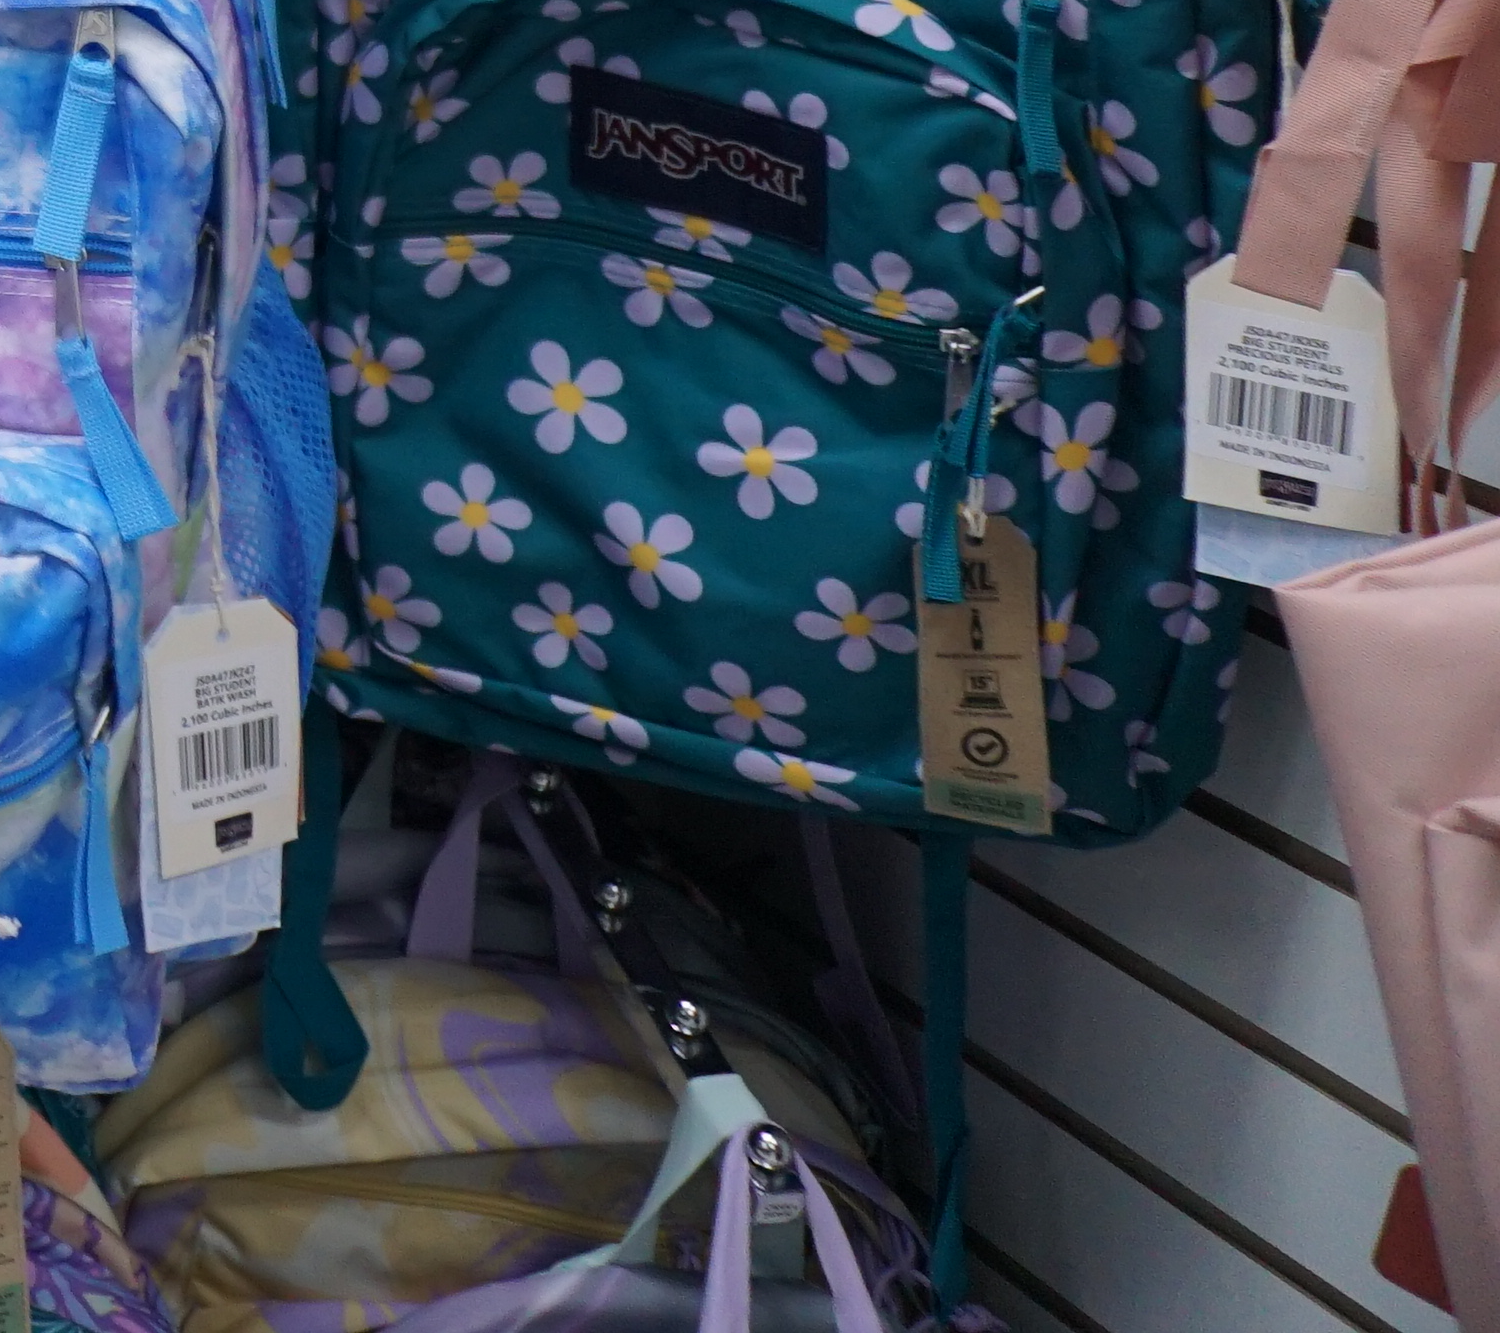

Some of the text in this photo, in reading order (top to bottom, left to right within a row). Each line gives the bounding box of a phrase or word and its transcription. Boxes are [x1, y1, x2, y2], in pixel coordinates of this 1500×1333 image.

[589, 108, 806, 205] JANSPORT
[1228, 343, 1345, 376] PRECIOUS PETALS
[1267, 339, 1330, 361] STUDENT
[1217, 356, 1350, 392] 2,100 Cubic Inches
[1219, 440, 1331, 472] MADE IN INDONESIA
[195, 677, 256, 699] BIG STUDENT
[196, 688, 257, 709] BATIK WASH
[211, 707, 239, 721] Cubic
[241, 700, 273, 715] Inches
[192, 798, 215, 810] MADE
